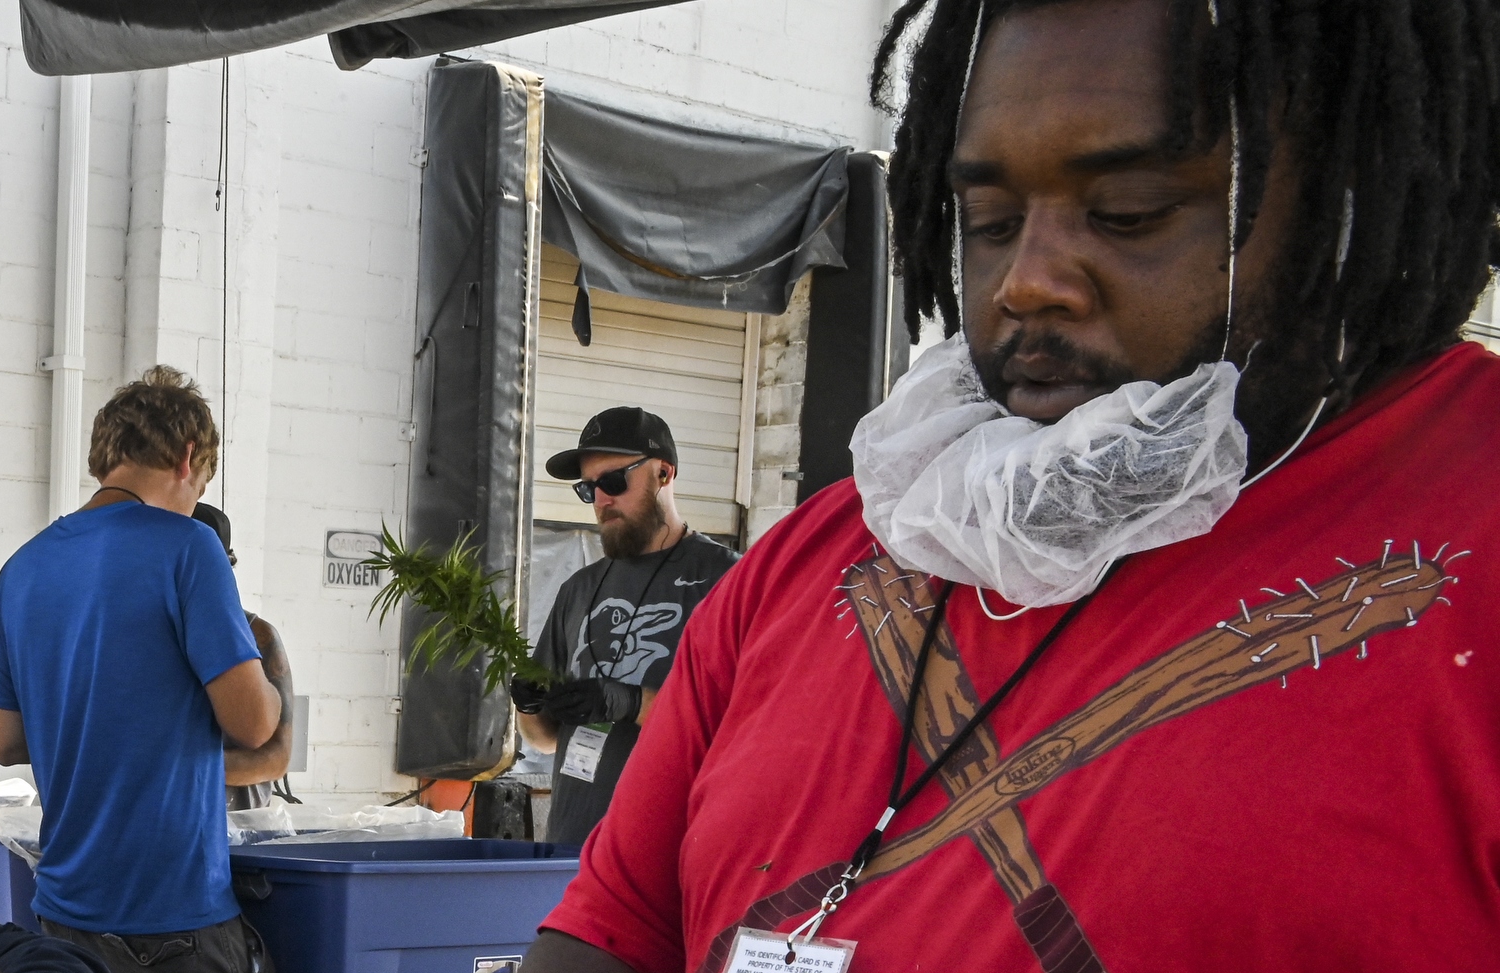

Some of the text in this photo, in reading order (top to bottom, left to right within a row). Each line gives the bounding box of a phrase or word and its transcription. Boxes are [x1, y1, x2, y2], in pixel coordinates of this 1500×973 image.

[333, 538, 377, 553] DANGER
[327, 562, 380, 587] OXYGEN
[748, 960, 774, 969] PROPERTY
[757, 951, 796, 963] IDENTIFICA
[798, 957, 814, 965] CARD
[822, 960, 834, 968] THE
